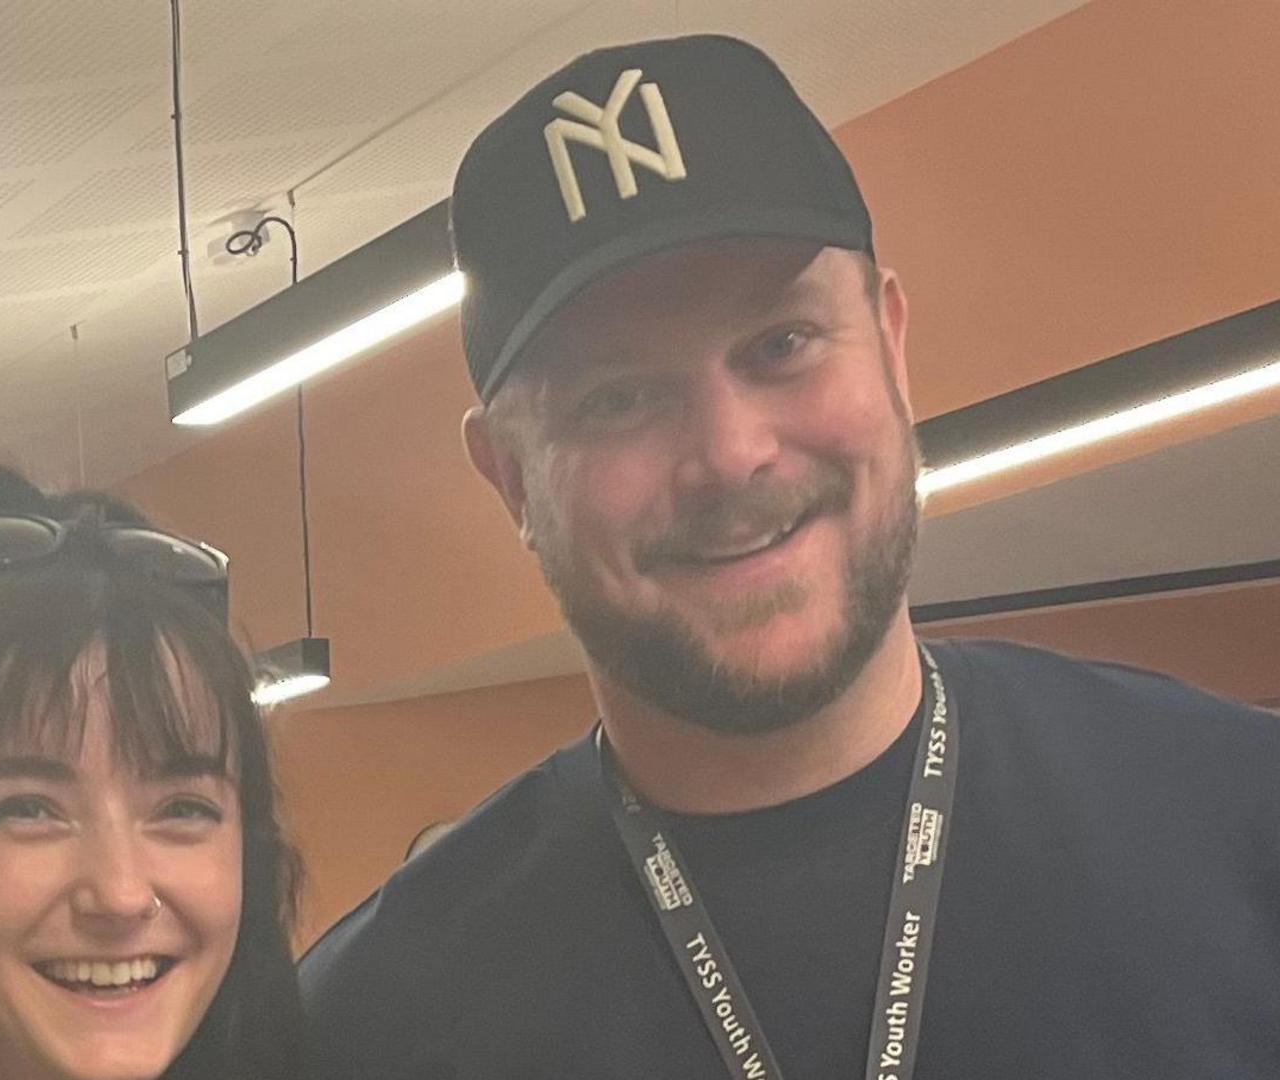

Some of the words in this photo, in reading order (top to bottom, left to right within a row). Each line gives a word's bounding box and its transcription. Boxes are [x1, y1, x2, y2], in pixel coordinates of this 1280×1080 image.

[924, 727, 946, 777] TYSS
[920, 811, 936, 863] YOUTH
[649, 856, 679, 908] YOUTH
[890, 911, 922, 996] Worker
[686, 932, 722, 989] TYSS
[712, 987, 750, 1055] Youth
[880, 1000, 909, 1067] Youth
